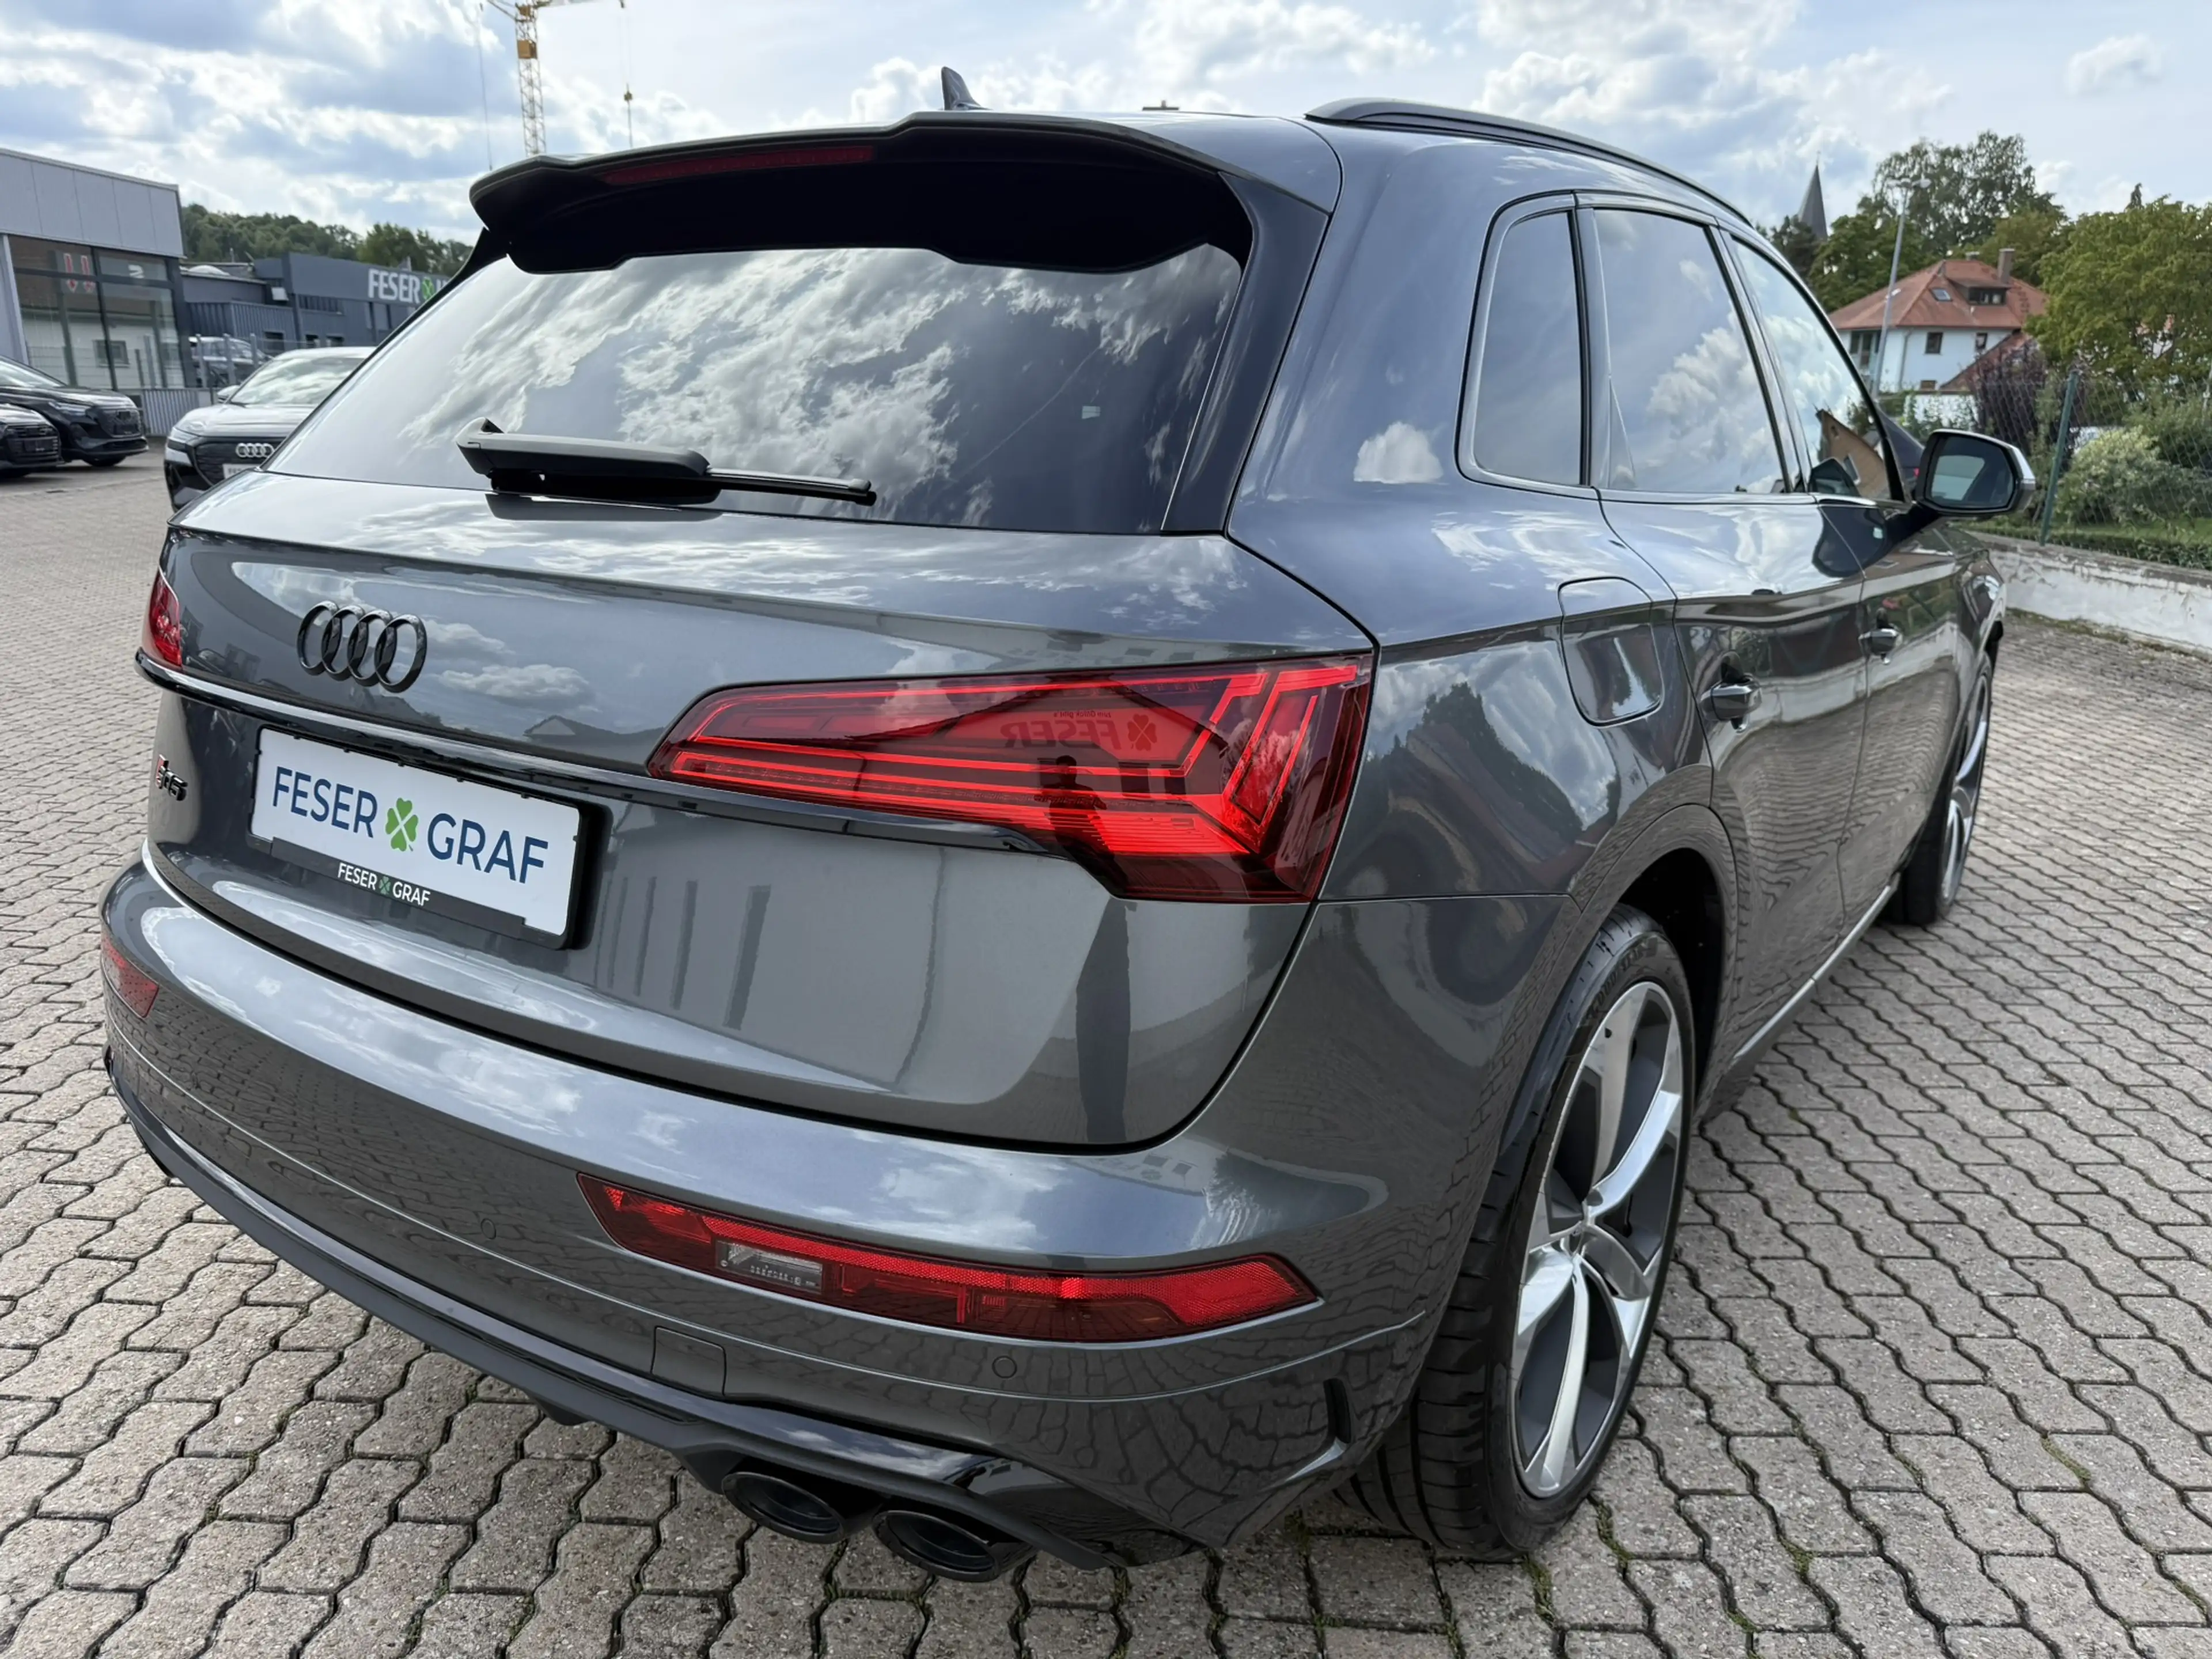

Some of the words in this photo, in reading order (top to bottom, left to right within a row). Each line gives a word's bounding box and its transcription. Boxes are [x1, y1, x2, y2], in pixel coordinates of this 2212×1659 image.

[368, 268, 421, 304] FESER
[272, 766, 378, 838] FESER
[427, 813, 548, 884] GRAF
[338, 862, 377, 890] FESER
[392, 881, 431, 906] GRAF
